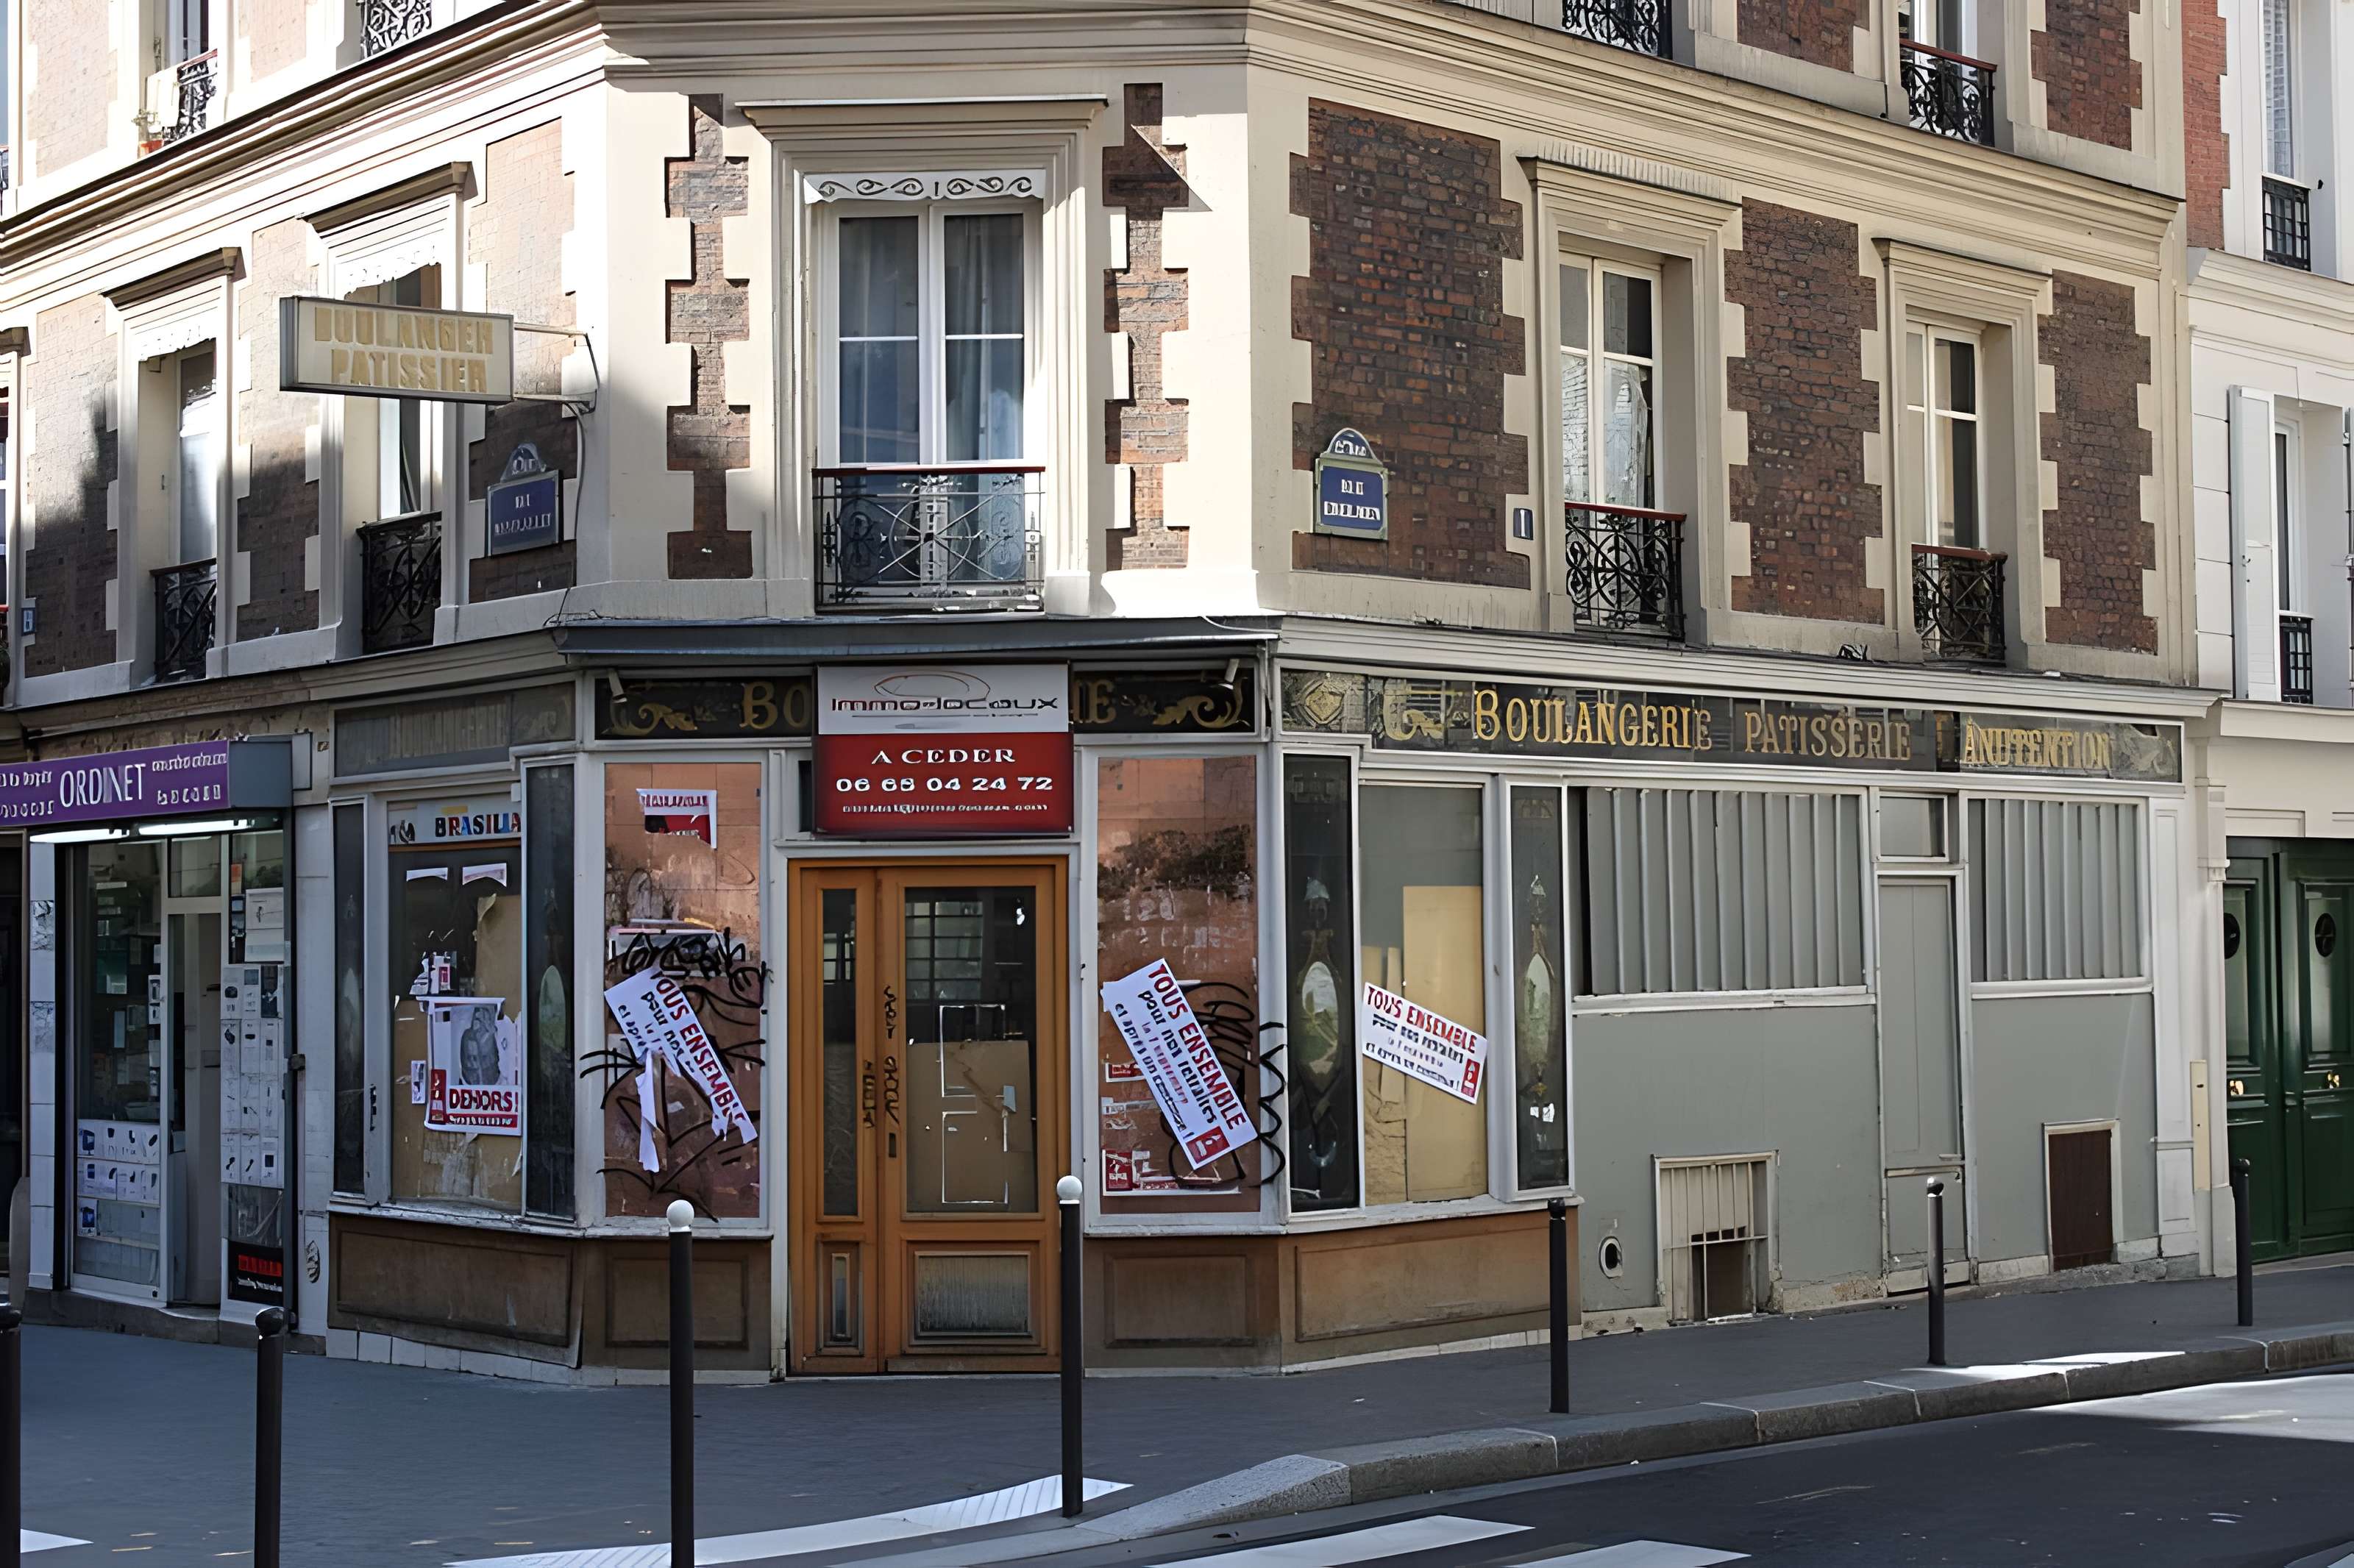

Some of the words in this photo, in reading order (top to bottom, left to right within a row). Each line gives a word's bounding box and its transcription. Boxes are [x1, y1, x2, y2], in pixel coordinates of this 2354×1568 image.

[1474, 688, 1713, 751] BOULANGERIE
[1744, 710, 1912, 761] PATISSERIE
[836, 777, 871, 792] 06
[926, 777, 961, 792] 04
[972, 777, 1007, 792] 24
[1017, 776, 1053, 791] 72
[871, 749, 893, 765] A
[902, 749, 1016, 764] CEDER
[59, 763, 146, 808] ORDINET
[1137, 990, 1167, 1025] pour
[1367, 986, 1404, 1019] TOUS
[1406, 1005, 1478, 1054] ENSEMBLE
[680, 1023, 747, 1122] ENSEMB
[1148, 963, 1189, 1020] TOUS
[1178, 1022, 1247, 1130] ENSEMBLE
